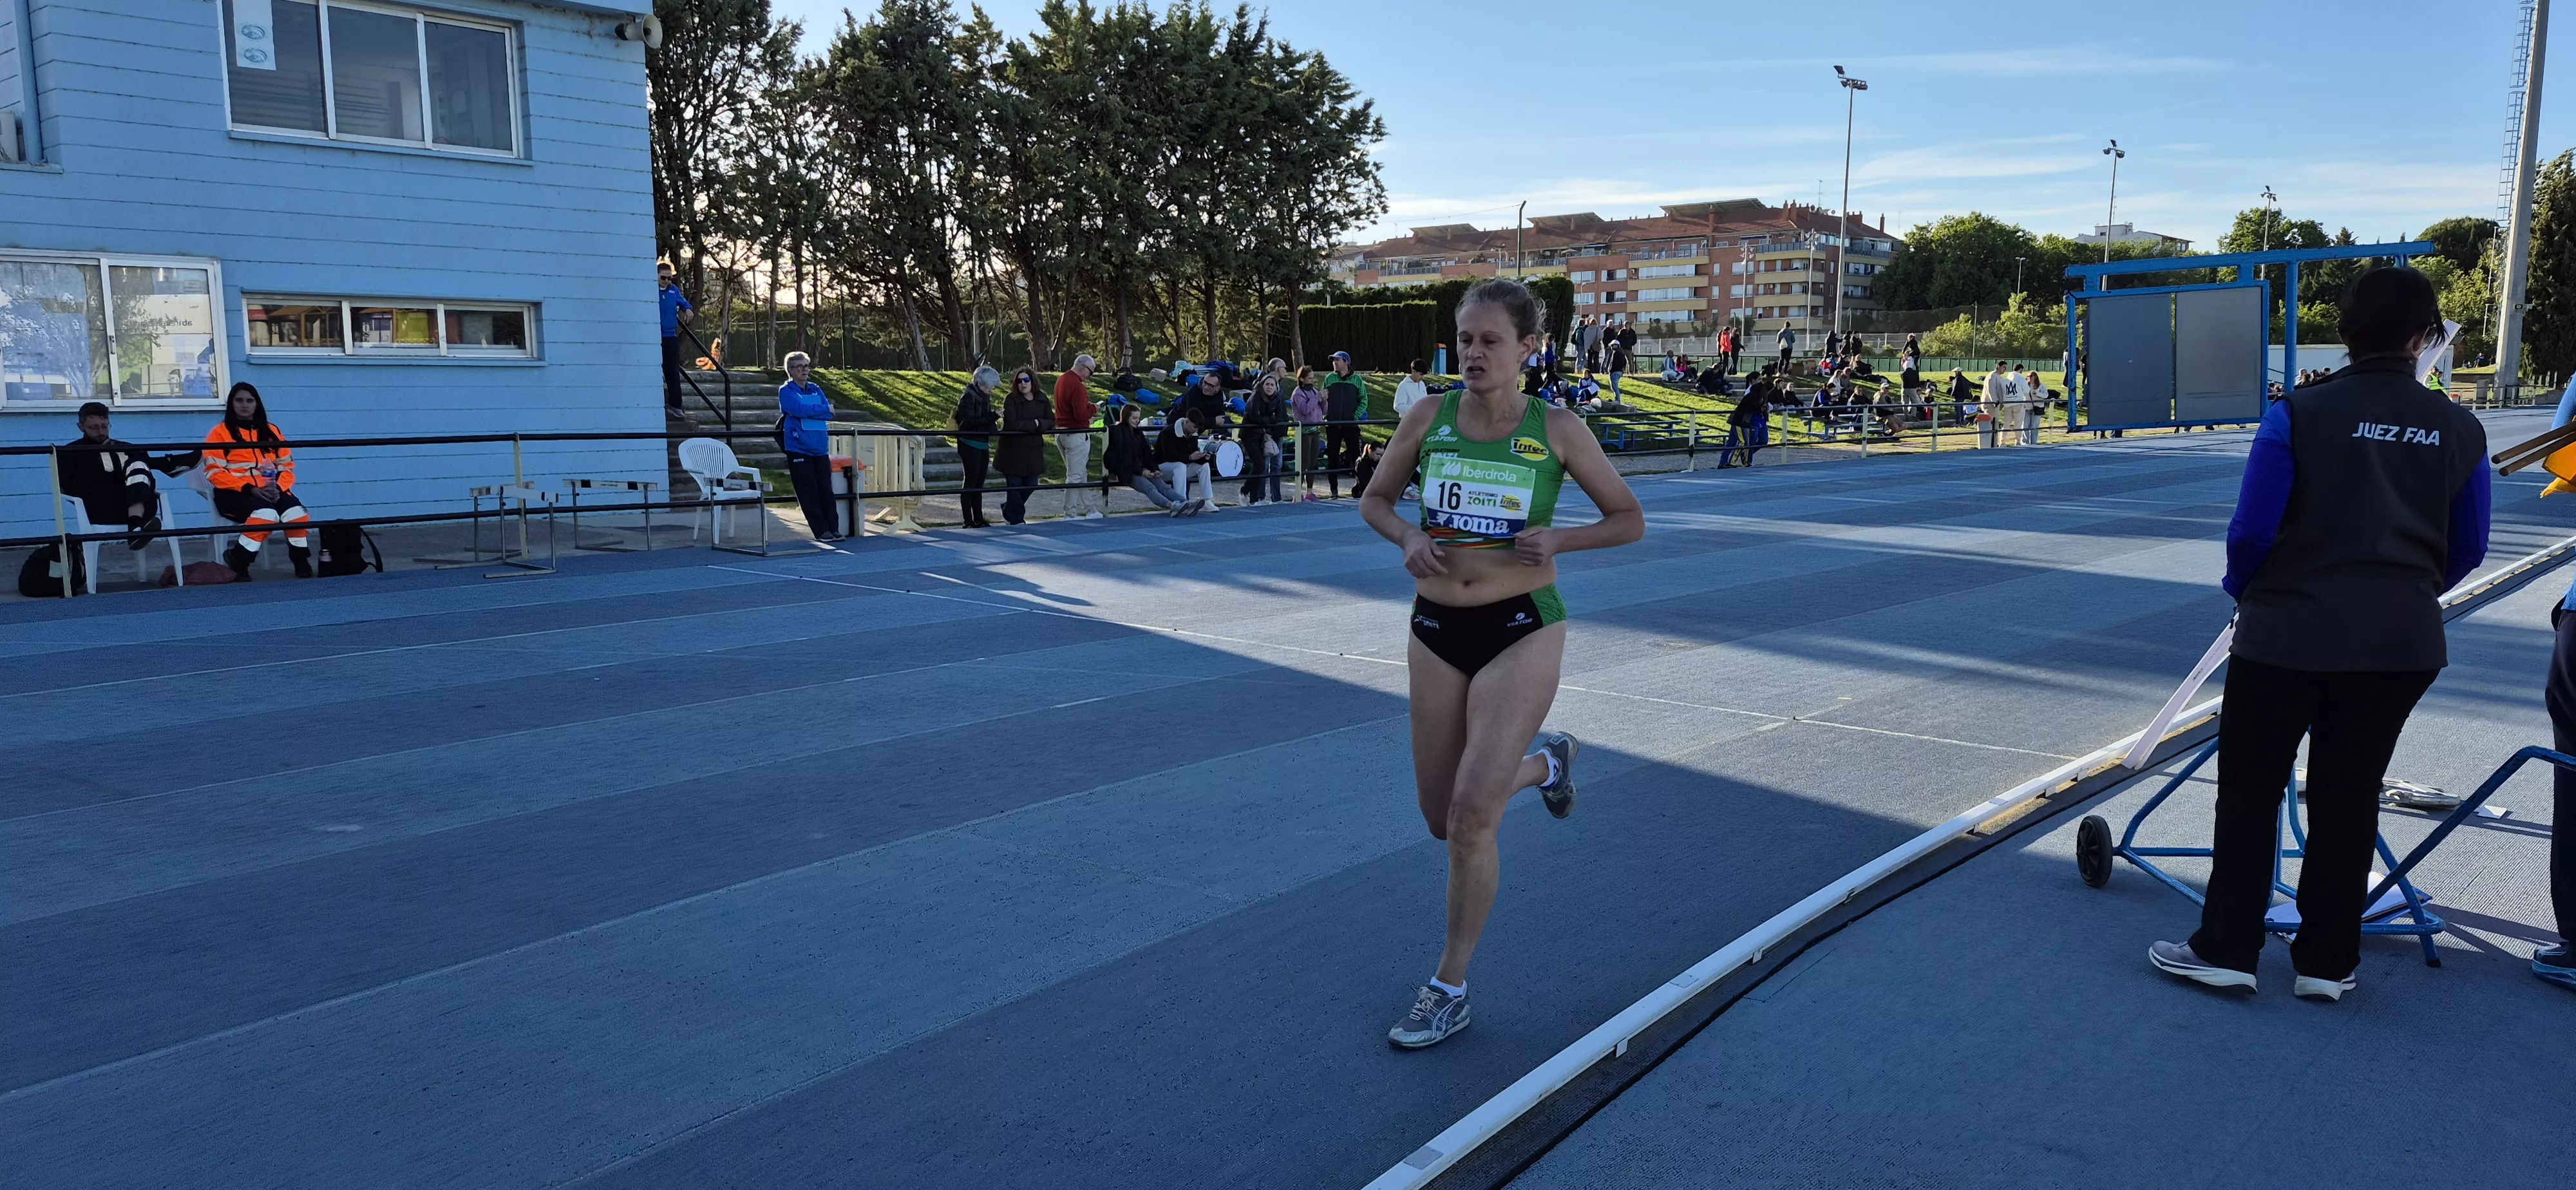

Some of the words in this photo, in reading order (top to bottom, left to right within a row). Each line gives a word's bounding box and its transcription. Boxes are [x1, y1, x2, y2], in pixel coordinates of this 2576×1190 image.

[2352, 422, 2400, 441] JUEZ
[2402, 427, 2439, 446] FAA
[1463, 466, 1517, 482] Iberdrola
[1438, 481, 1462, 510] 16
[1467, 496, 1496, 507] ZOITI
[1507, 618, 1533, 627] VIATOR
